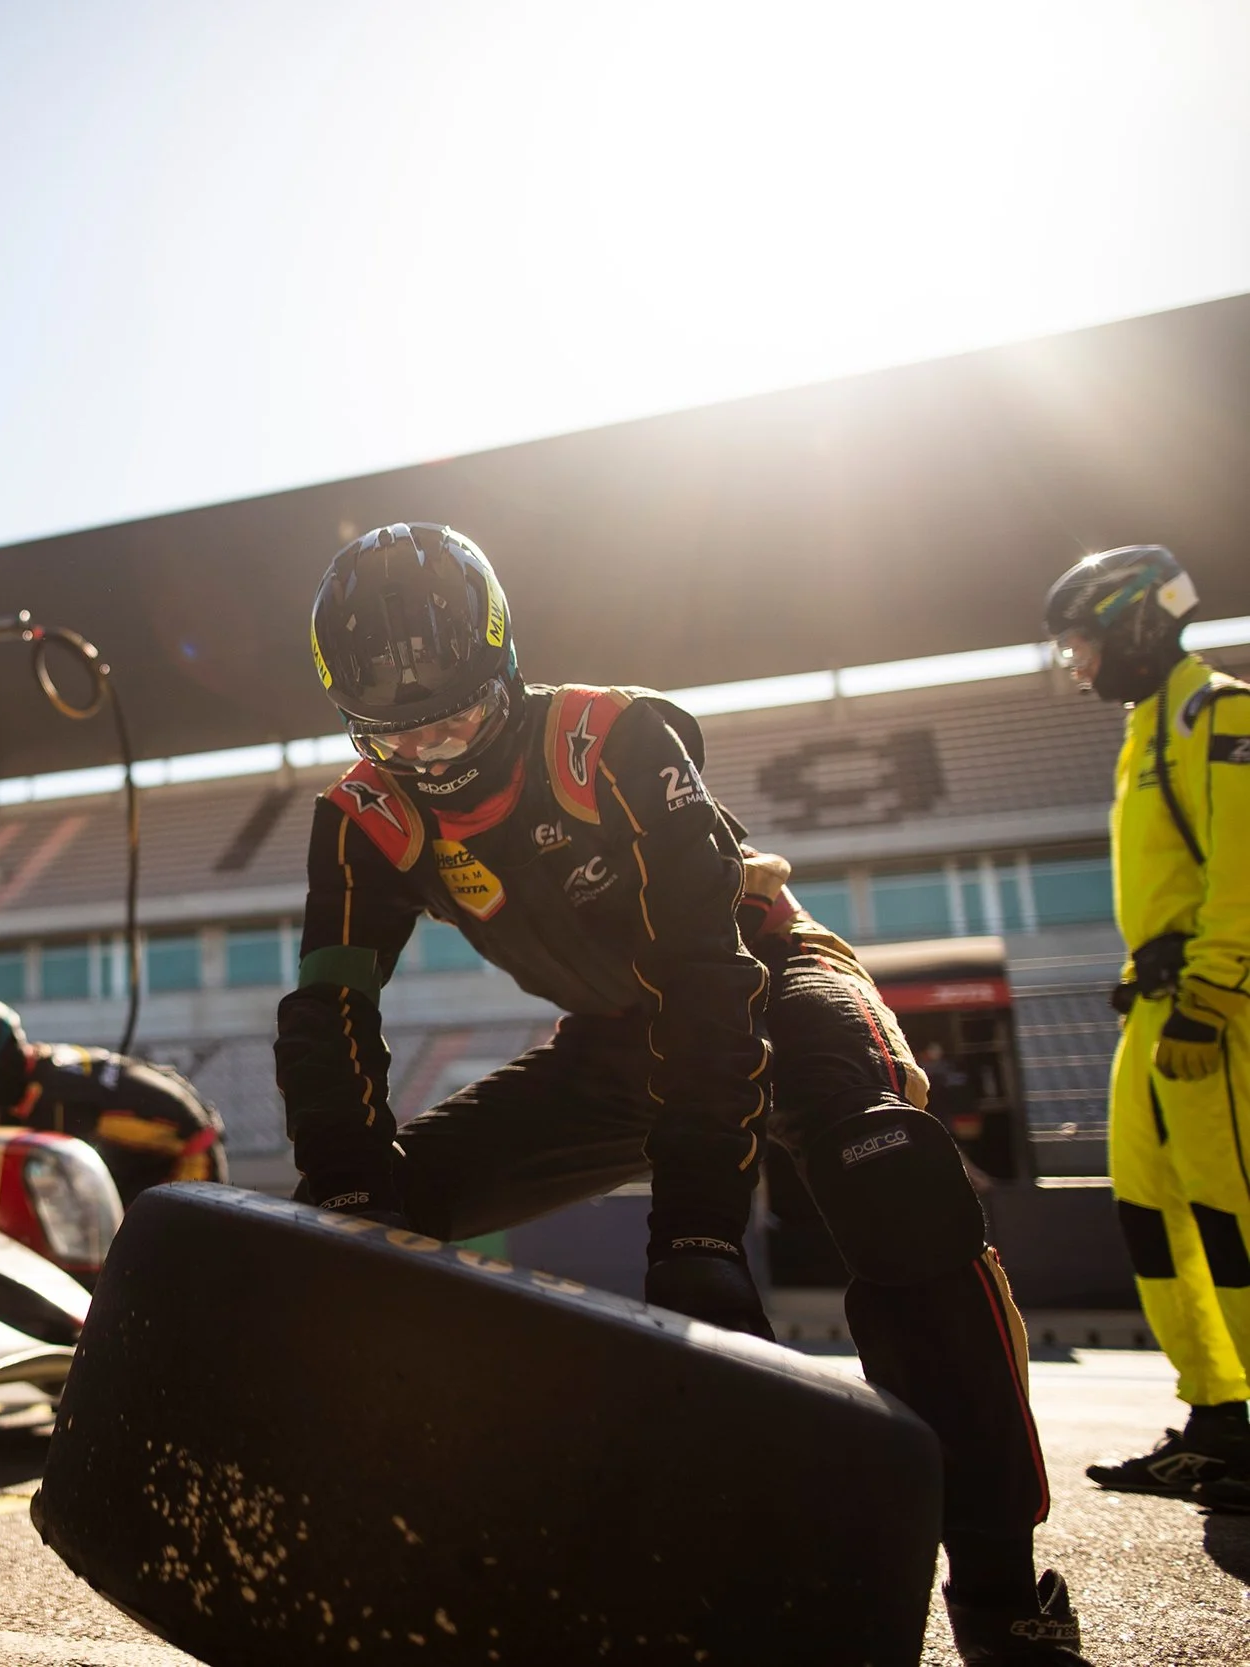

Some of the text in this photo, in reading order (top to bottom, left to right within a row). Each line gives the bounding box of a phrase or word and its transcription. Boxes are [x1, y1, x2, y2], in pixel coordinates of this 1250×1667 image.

[417, 768, 479, 794] sparco
[667, 798, 685, 812] LE
[436, 850, 476, 868] Hertz
[454, 885, 490, 894] JOTA
[841, 1129, 909, 1165] sparco
